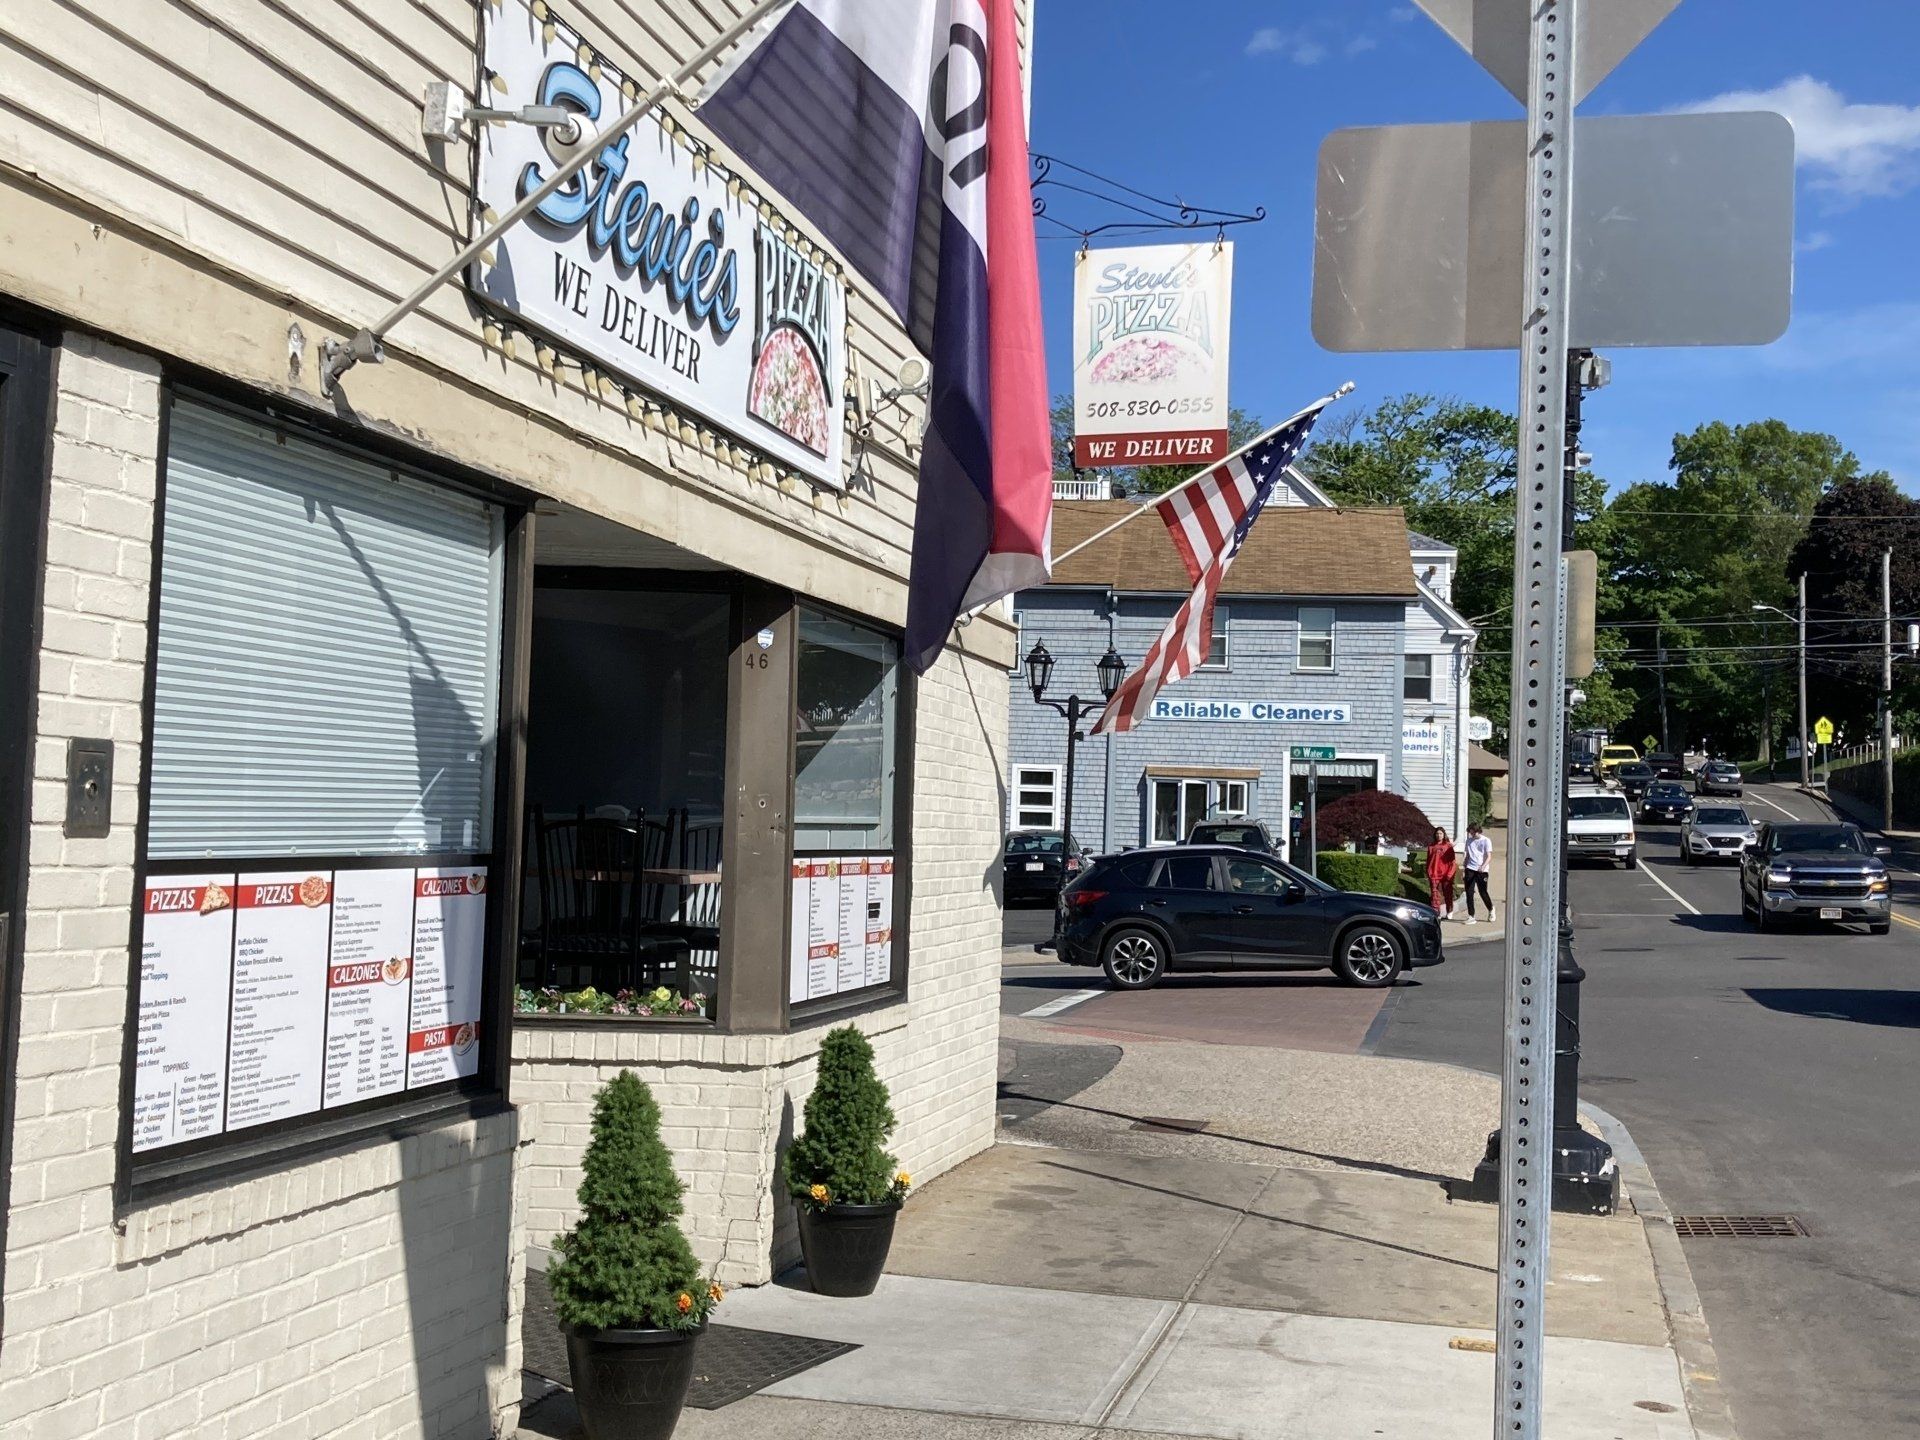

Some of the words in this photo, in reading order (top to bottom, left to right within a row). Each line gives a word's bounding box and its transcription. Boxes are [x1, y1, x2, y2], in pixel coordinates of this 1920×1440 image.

[521, 61, 740, 334] Stevie's
[553, 252, 592, 318] WE
[1096, 262, 1200, 294] Stevie's
[759, 221, 832, 394] PIZZA
[601, 284, 701, 384] DELIVER
[1087, 290, 1214, 364] PIZZA
[1086, 397, 1214, 418] 508-830-0555
[1088, 441, 1117, 459] WE
[1124, 437, 1214, 458] DELIVER
[745, 652, 769, 670] 46
[1156, 702, 1241, 718] Reliable
[1252, 704, 1344, 721] Cleaners
[1402, 729, 1438, 739] eliable
[1302, 747, 1323, 758] Water
[1402, 743, 1439, 751] leaners
[254, 885, 295, 905] PIZZAS
[422, 879, 463, 895] CALZONES
[149, 889, 196, 911] PIZZAS
[333, 963, 380, 984] CALZONES
[423, 1030, 446, 1047] PASTA
